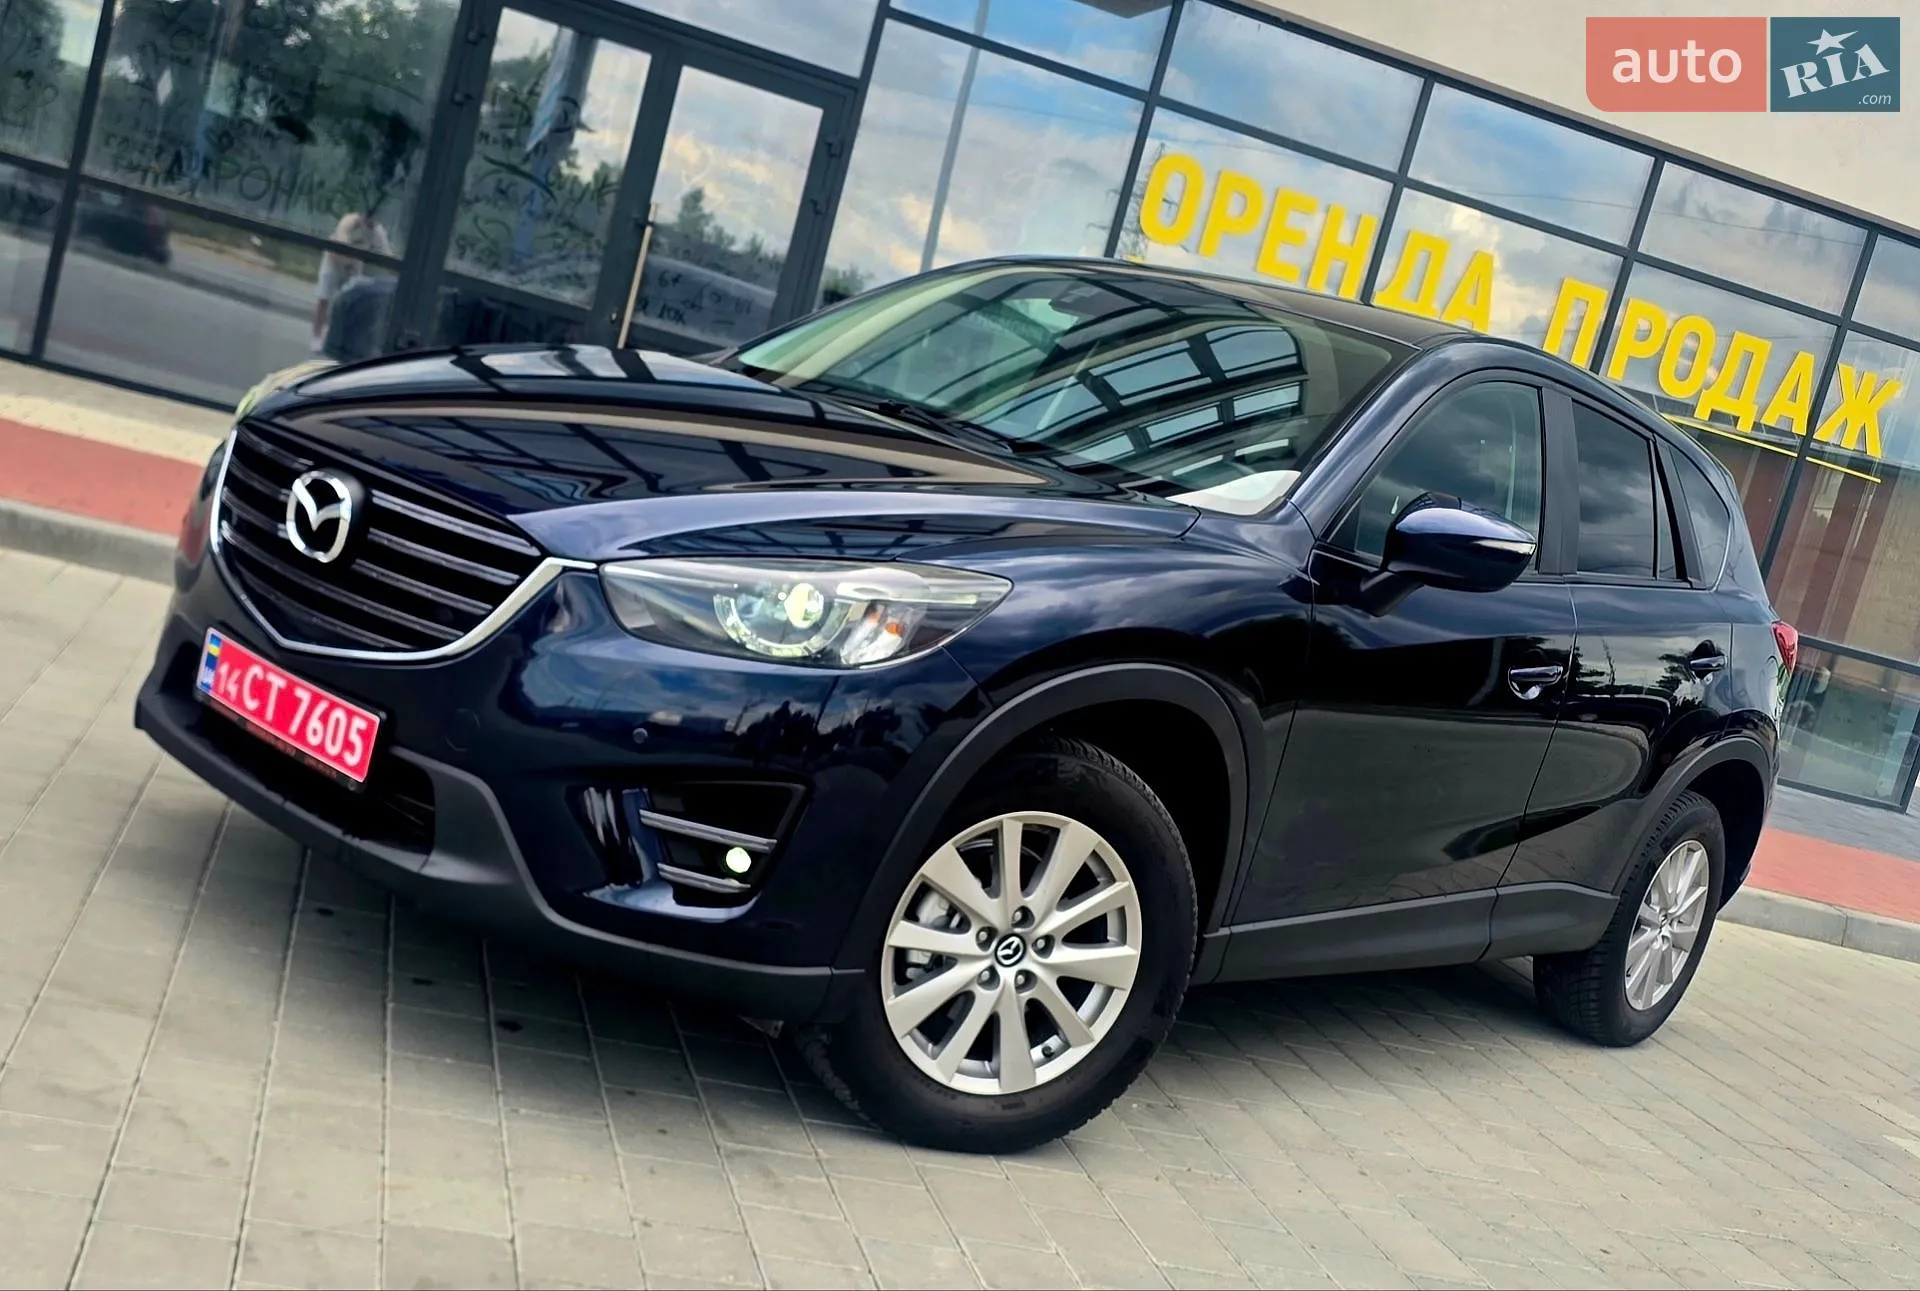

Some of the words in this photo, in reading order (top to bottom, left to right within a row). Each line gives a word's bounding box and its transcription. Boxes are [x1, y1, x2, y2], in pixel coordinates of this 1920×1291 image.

[1141, 153, 1494, 335] ОРЕНДА
[1544, 278, 1901, 458] ПРОДАЖ
[287, 686, 369, 768] 7605
